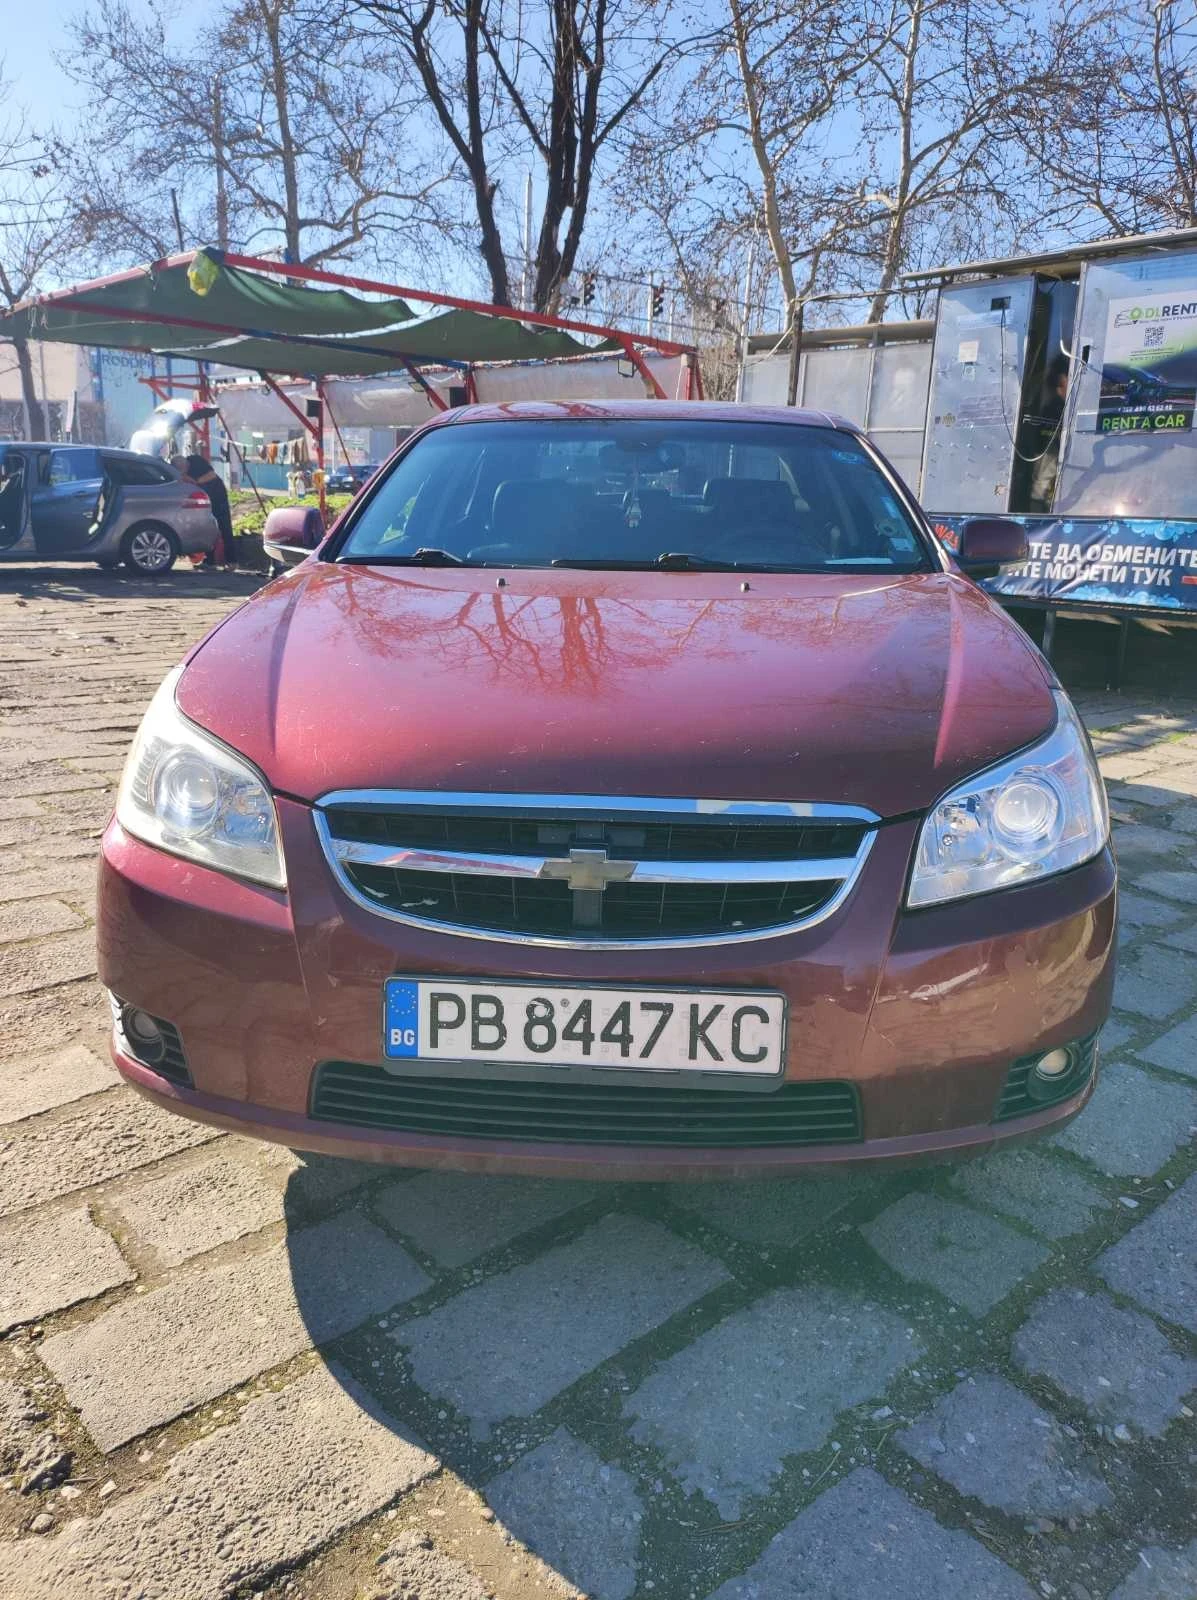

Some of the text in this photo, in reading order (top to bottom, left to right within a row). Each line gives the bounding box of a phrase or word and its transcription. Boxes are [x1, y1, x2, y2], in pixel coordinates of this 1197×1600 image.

[1102, 414, 1185, 430] RENT A CAR
[1029, 542, 1197, 568] ТЕ ДА ОБМЕНИТЕ
[1132, 567, 1172, 587] ТУК
[390, 1028, 415, 1046] BG
[430, 992, 770, 1064] PB 8447 KC
